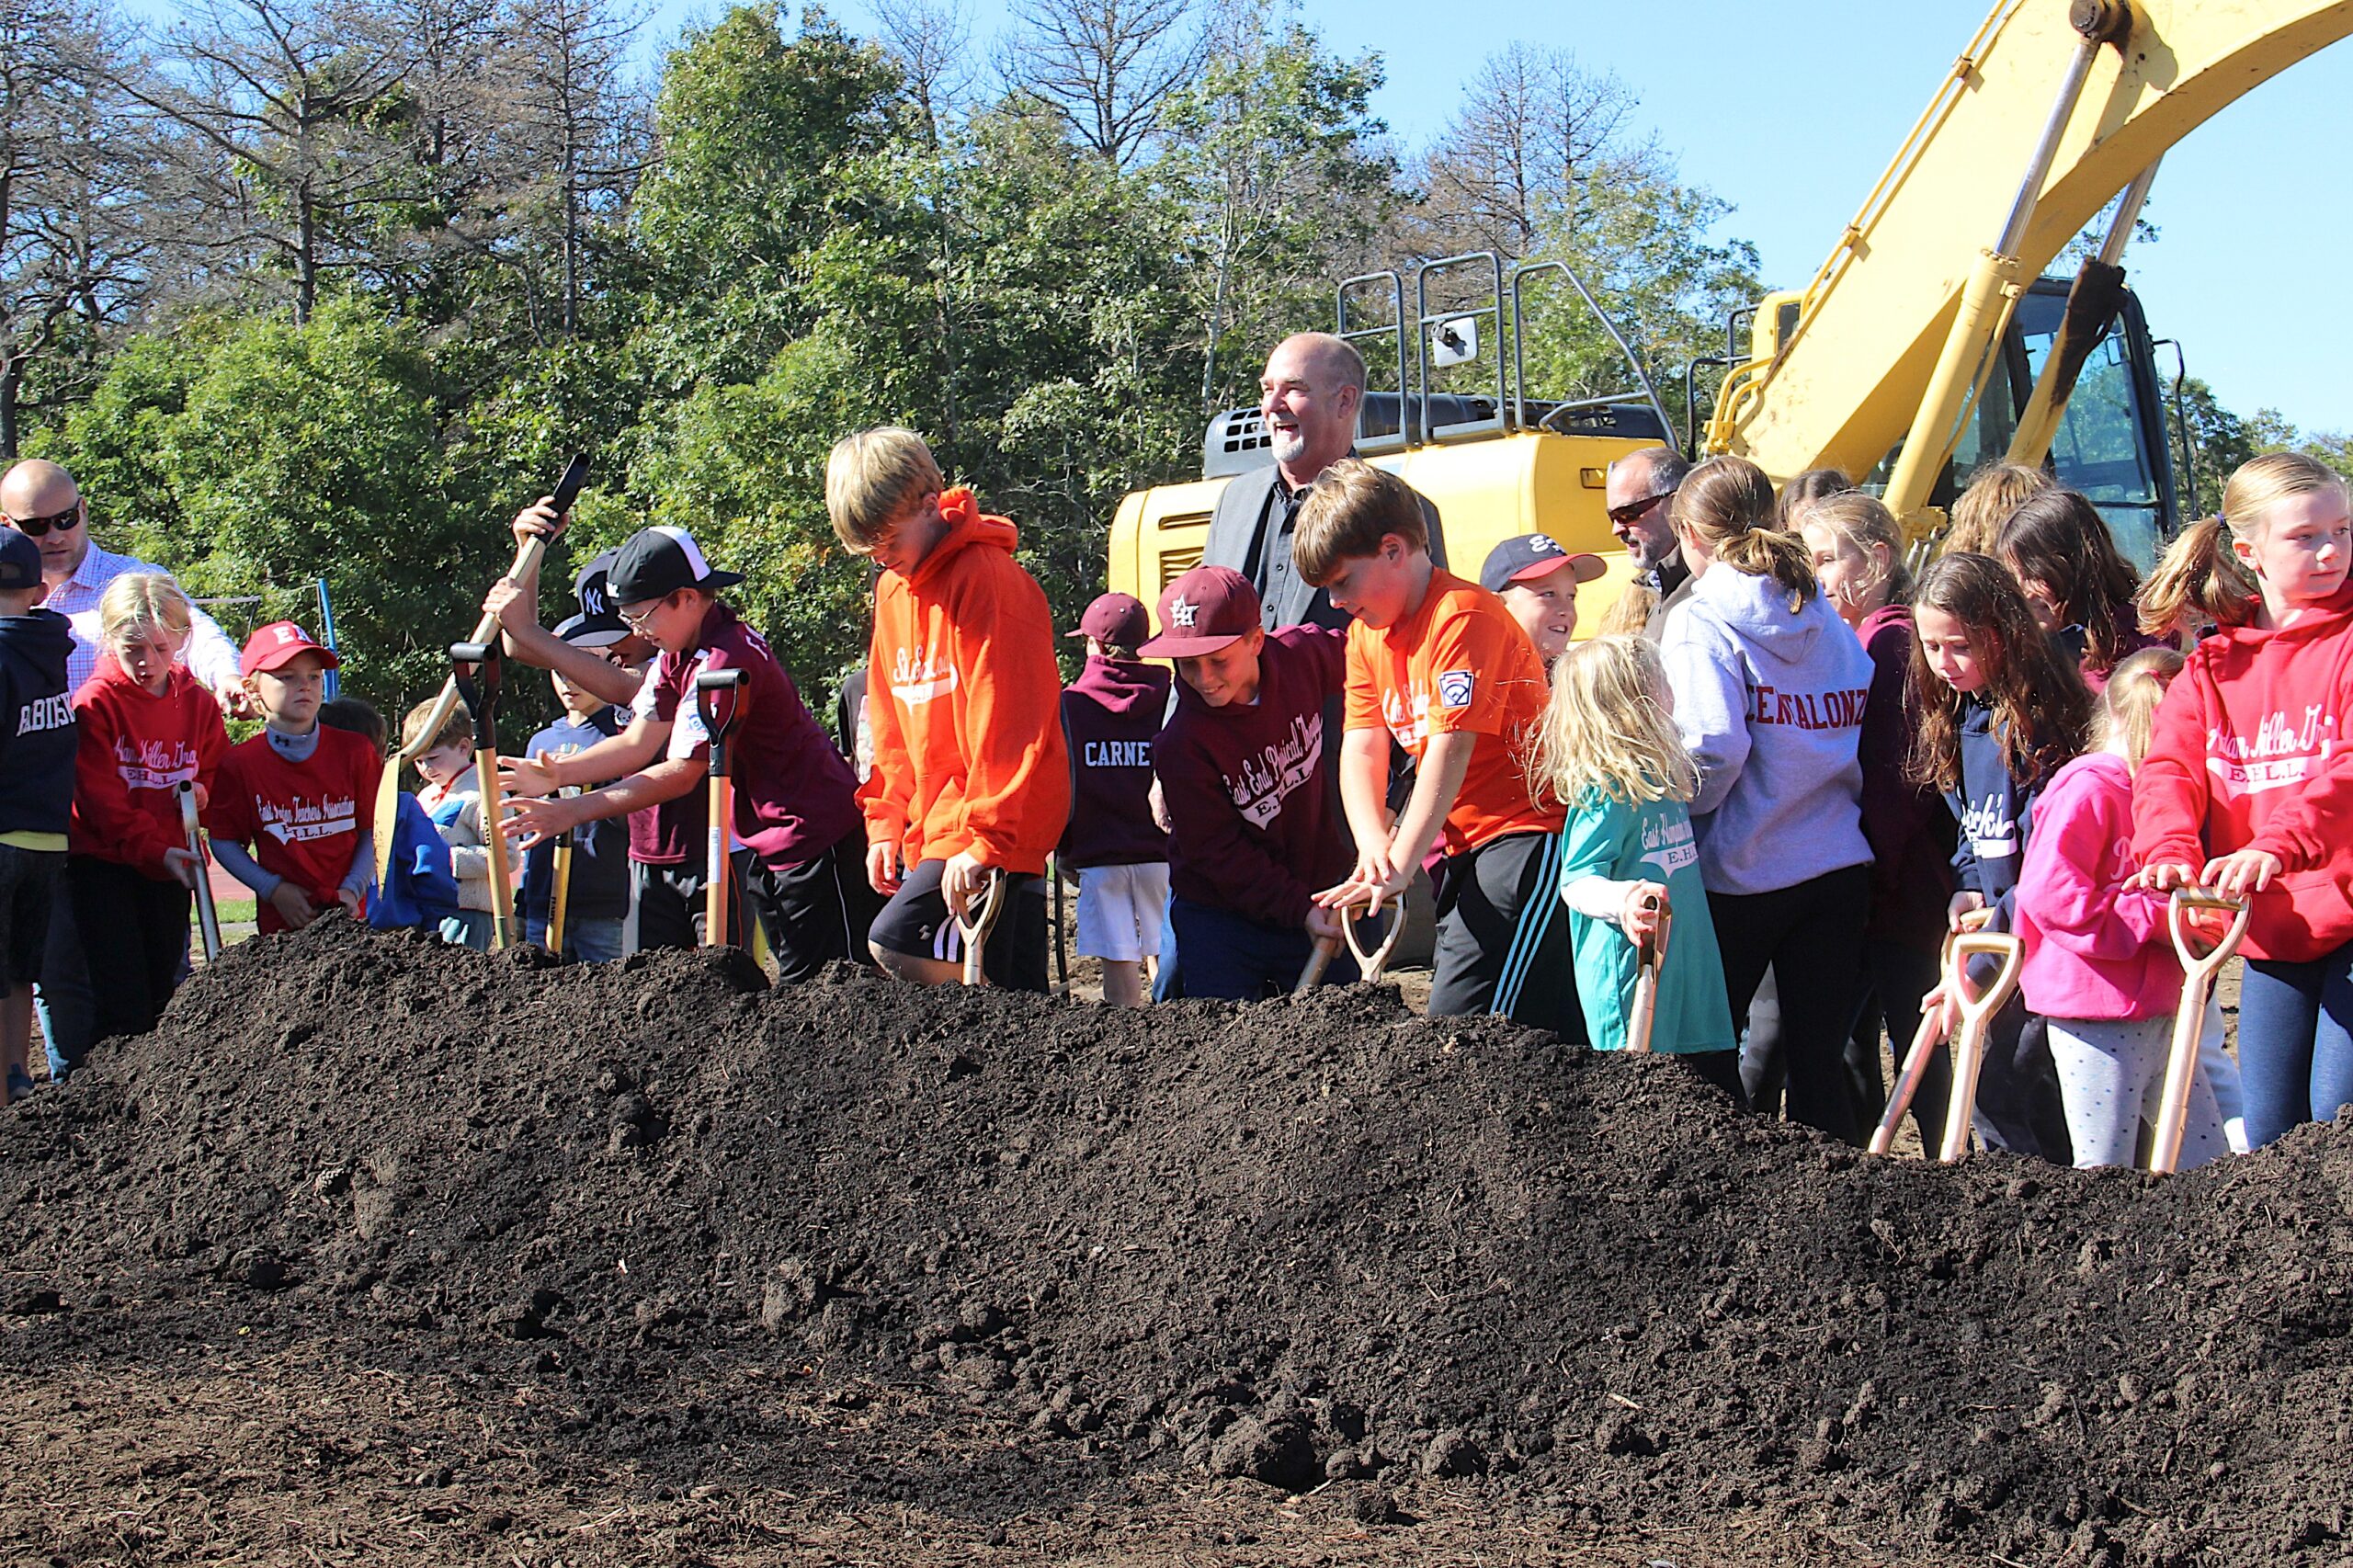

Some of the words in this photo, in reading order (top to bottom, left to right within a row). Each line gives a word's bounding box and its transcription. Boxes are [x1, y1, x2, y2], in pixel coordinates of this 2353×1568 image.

[1085, 741, 1153, 767] CARNE
[1243, 759, 1274, 796] End
[1641, 816, 1660, 851] East
